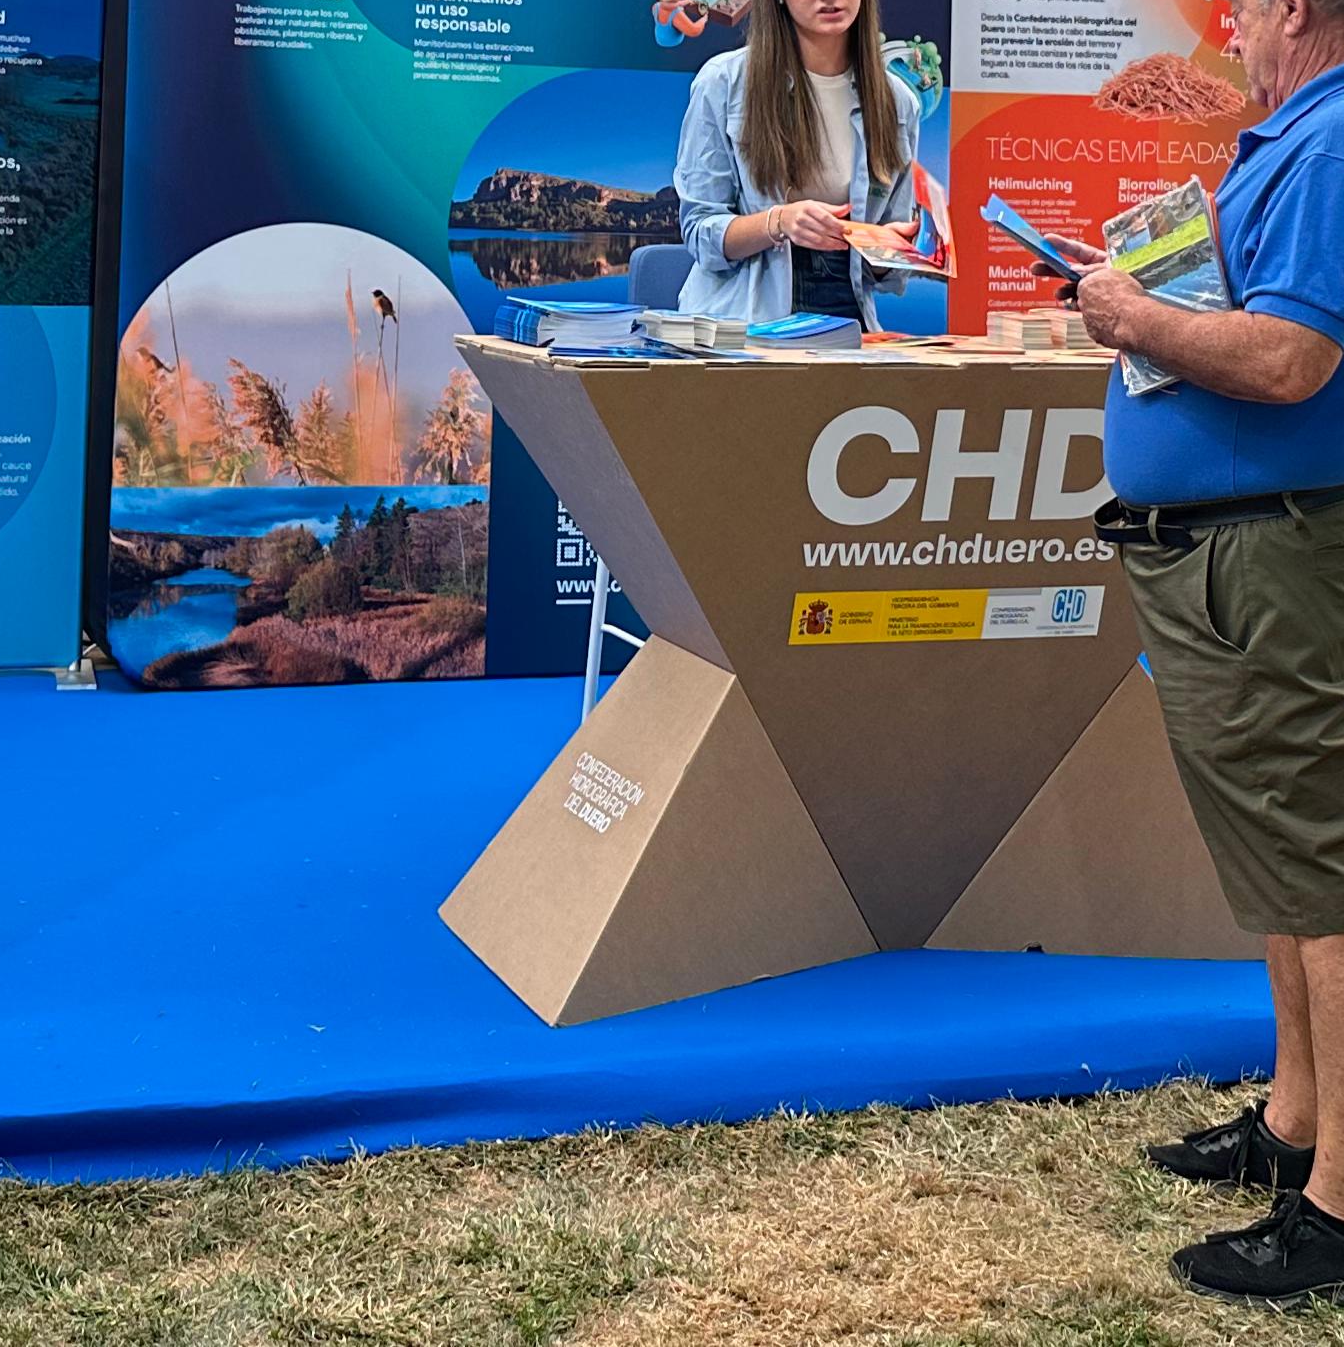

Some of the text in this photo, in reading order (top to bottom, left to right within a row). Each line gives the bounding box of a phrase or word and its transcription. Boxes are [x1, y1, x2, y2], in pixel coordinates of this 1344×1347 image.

[415, 16, 511, 34] responsable
[416, 3, 468, 17] un uso
[986, 132, 1103, 162] TÉCNICAS
[988, 177, 1072, 193] Helimulching
[1119, 178, 1178, 191] Biorrollos
[988, 279, 1036, 292] manual
[806, 405, 1115, 526] CHD
[802, 533, 1115, 568] www.chduero.es
[1051, 589, 1087, 623] CHD
[577, 752, 645, 805] CONFEDERACIÓN
[564, 792, 611, 833] DEL DUERO
